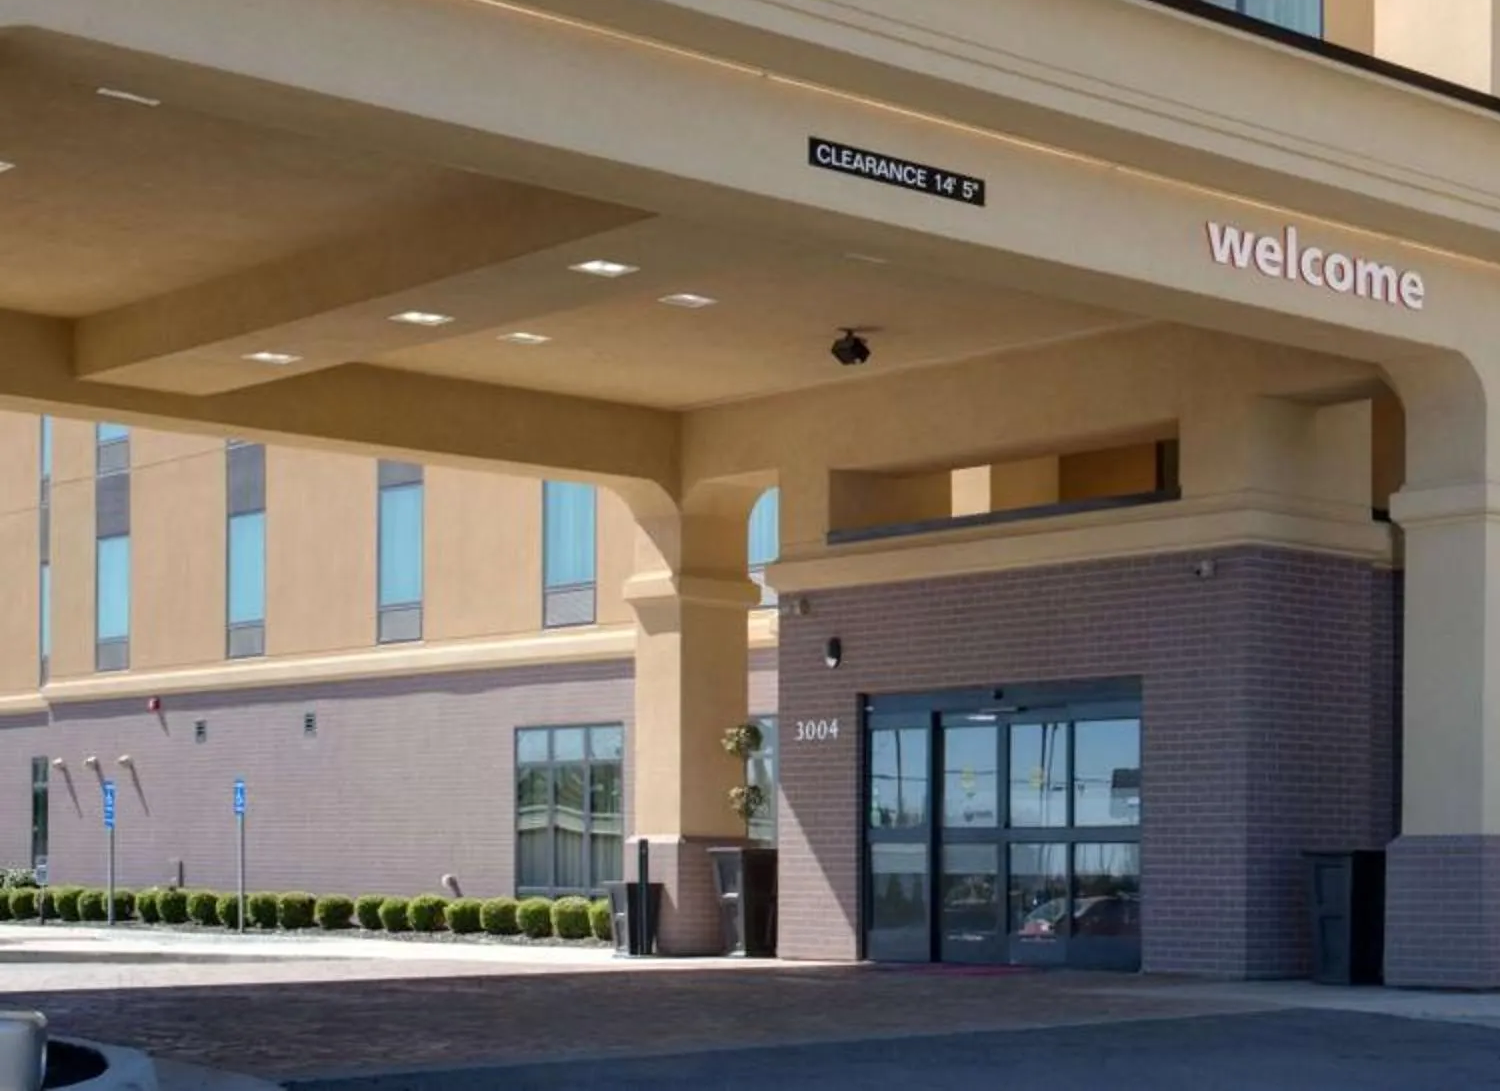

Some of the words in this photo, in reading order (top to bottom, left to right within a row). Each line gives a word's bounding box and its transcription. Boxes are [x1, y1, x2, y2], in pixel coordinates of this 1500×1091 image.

[816, 144, 927, 188] CLEARANCE
[1206, 221, 1425, 310] welcome
[793, 718, 838, 741] 3004
